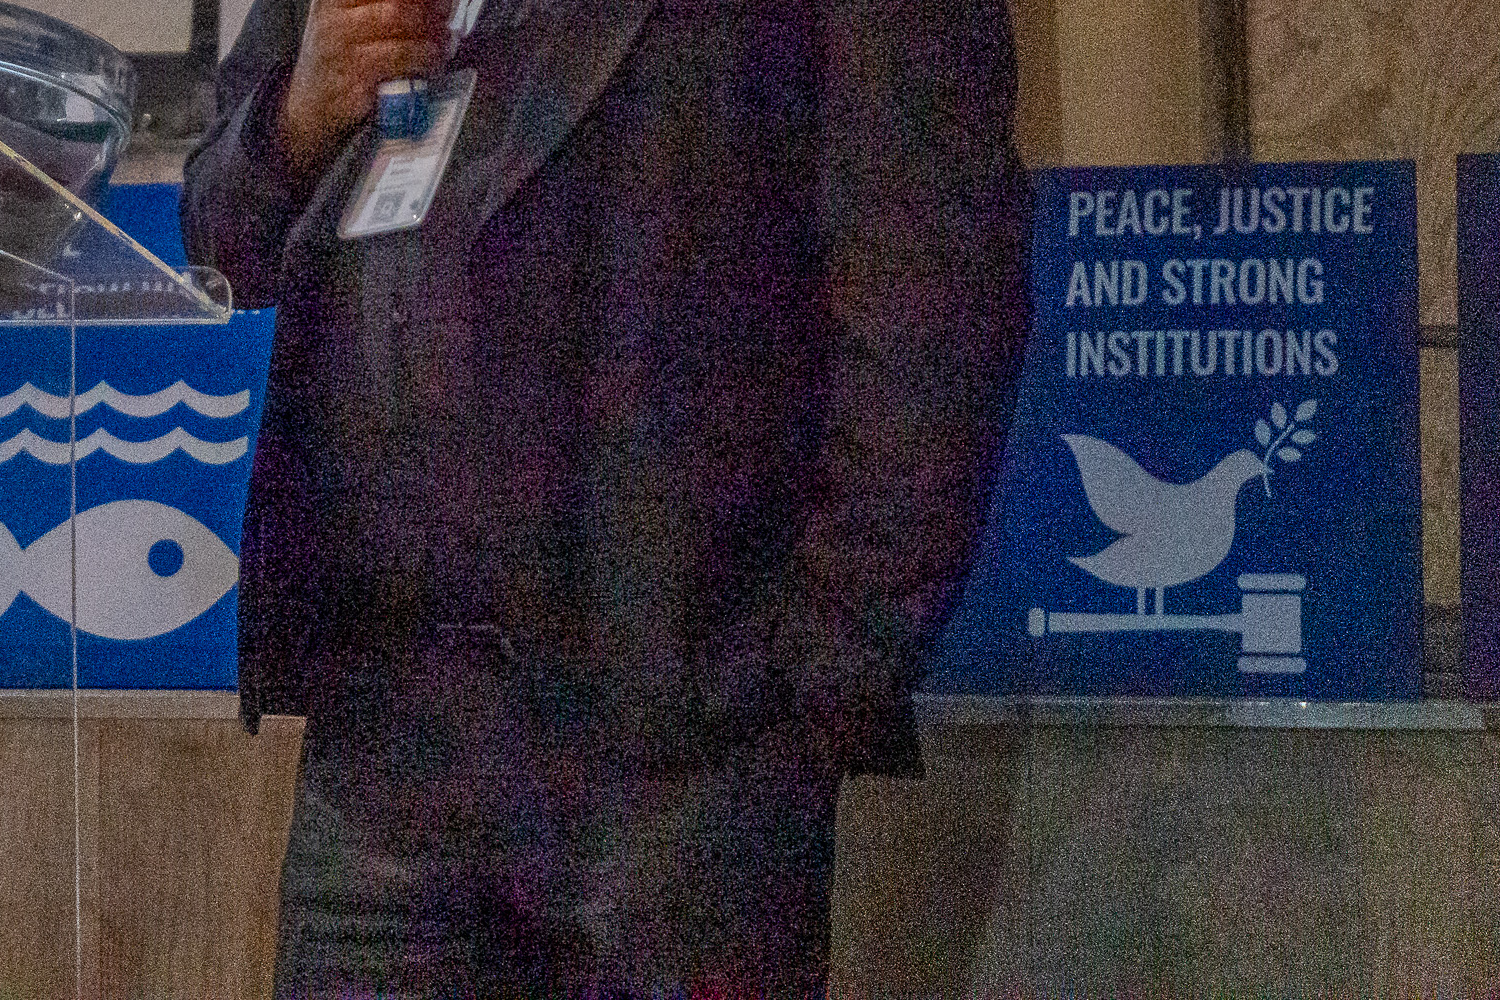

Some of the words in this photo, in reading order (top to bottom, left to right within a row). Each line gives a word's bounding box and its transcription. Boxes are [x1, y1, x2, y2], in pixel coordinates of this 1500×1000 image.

[1067, 188, 1200, 240] PEACE,
[1213, 187, 1374, 235] JUSTICE
[1066, 260, 1147, 306] AND
[1162, 258, 1324, 303] STRONG
[1066, 330, 1339, 378] INSTITUTIONS
